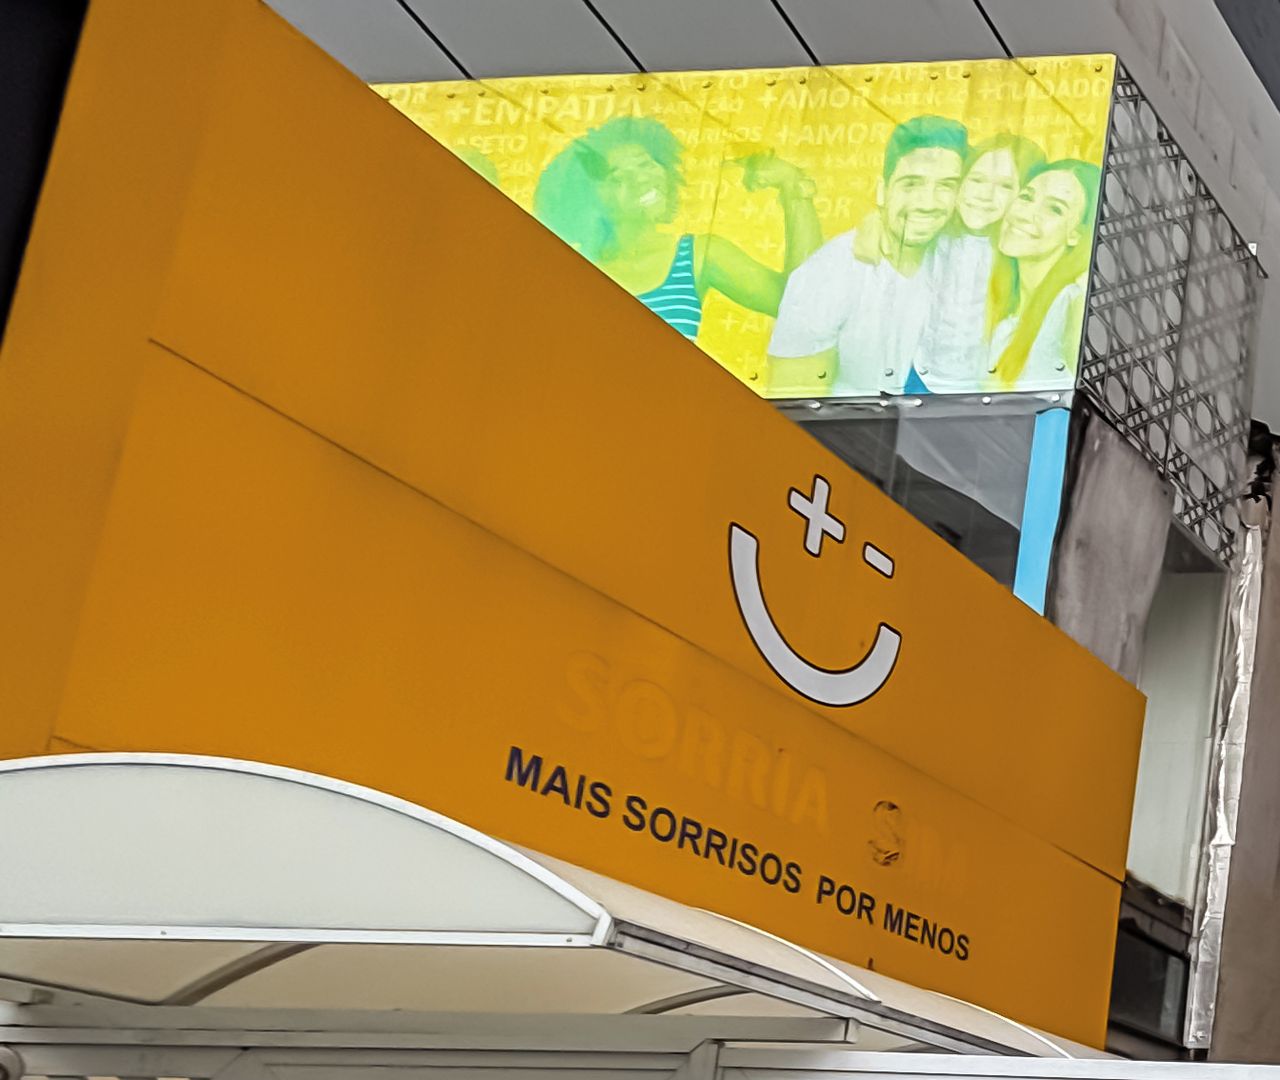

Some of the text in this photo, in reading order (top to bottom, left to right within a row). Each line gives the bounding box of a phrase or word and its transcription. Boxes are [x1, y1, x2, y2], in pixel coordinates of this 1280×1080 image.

[505, 746, 970, 962] MAIS SORRISOS POR MENOS
